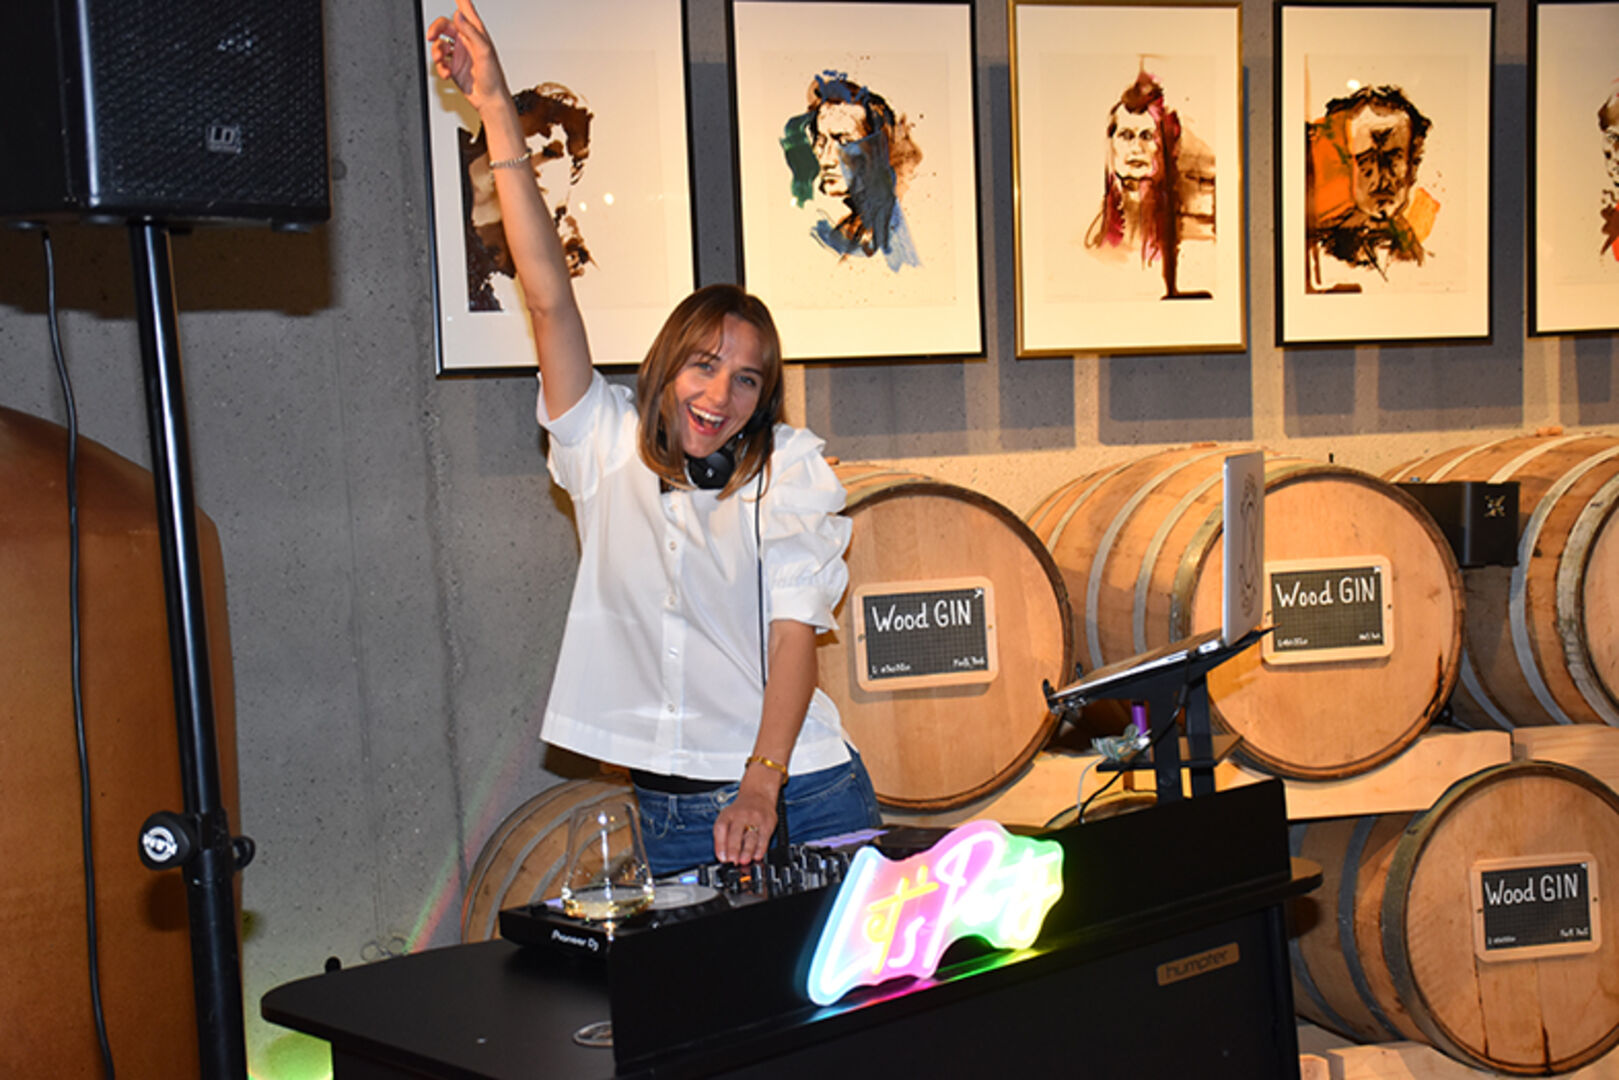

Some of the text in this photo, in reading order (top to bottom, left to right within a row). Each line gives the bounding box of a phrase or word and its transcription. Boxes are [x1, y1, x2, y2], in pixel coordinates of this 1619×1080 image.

[1275, 576, 1376, 608] Wood GIN
[871, 599, 973, 632] Wood GIN
[1484, 873, 1579, 906] Wood GIN
